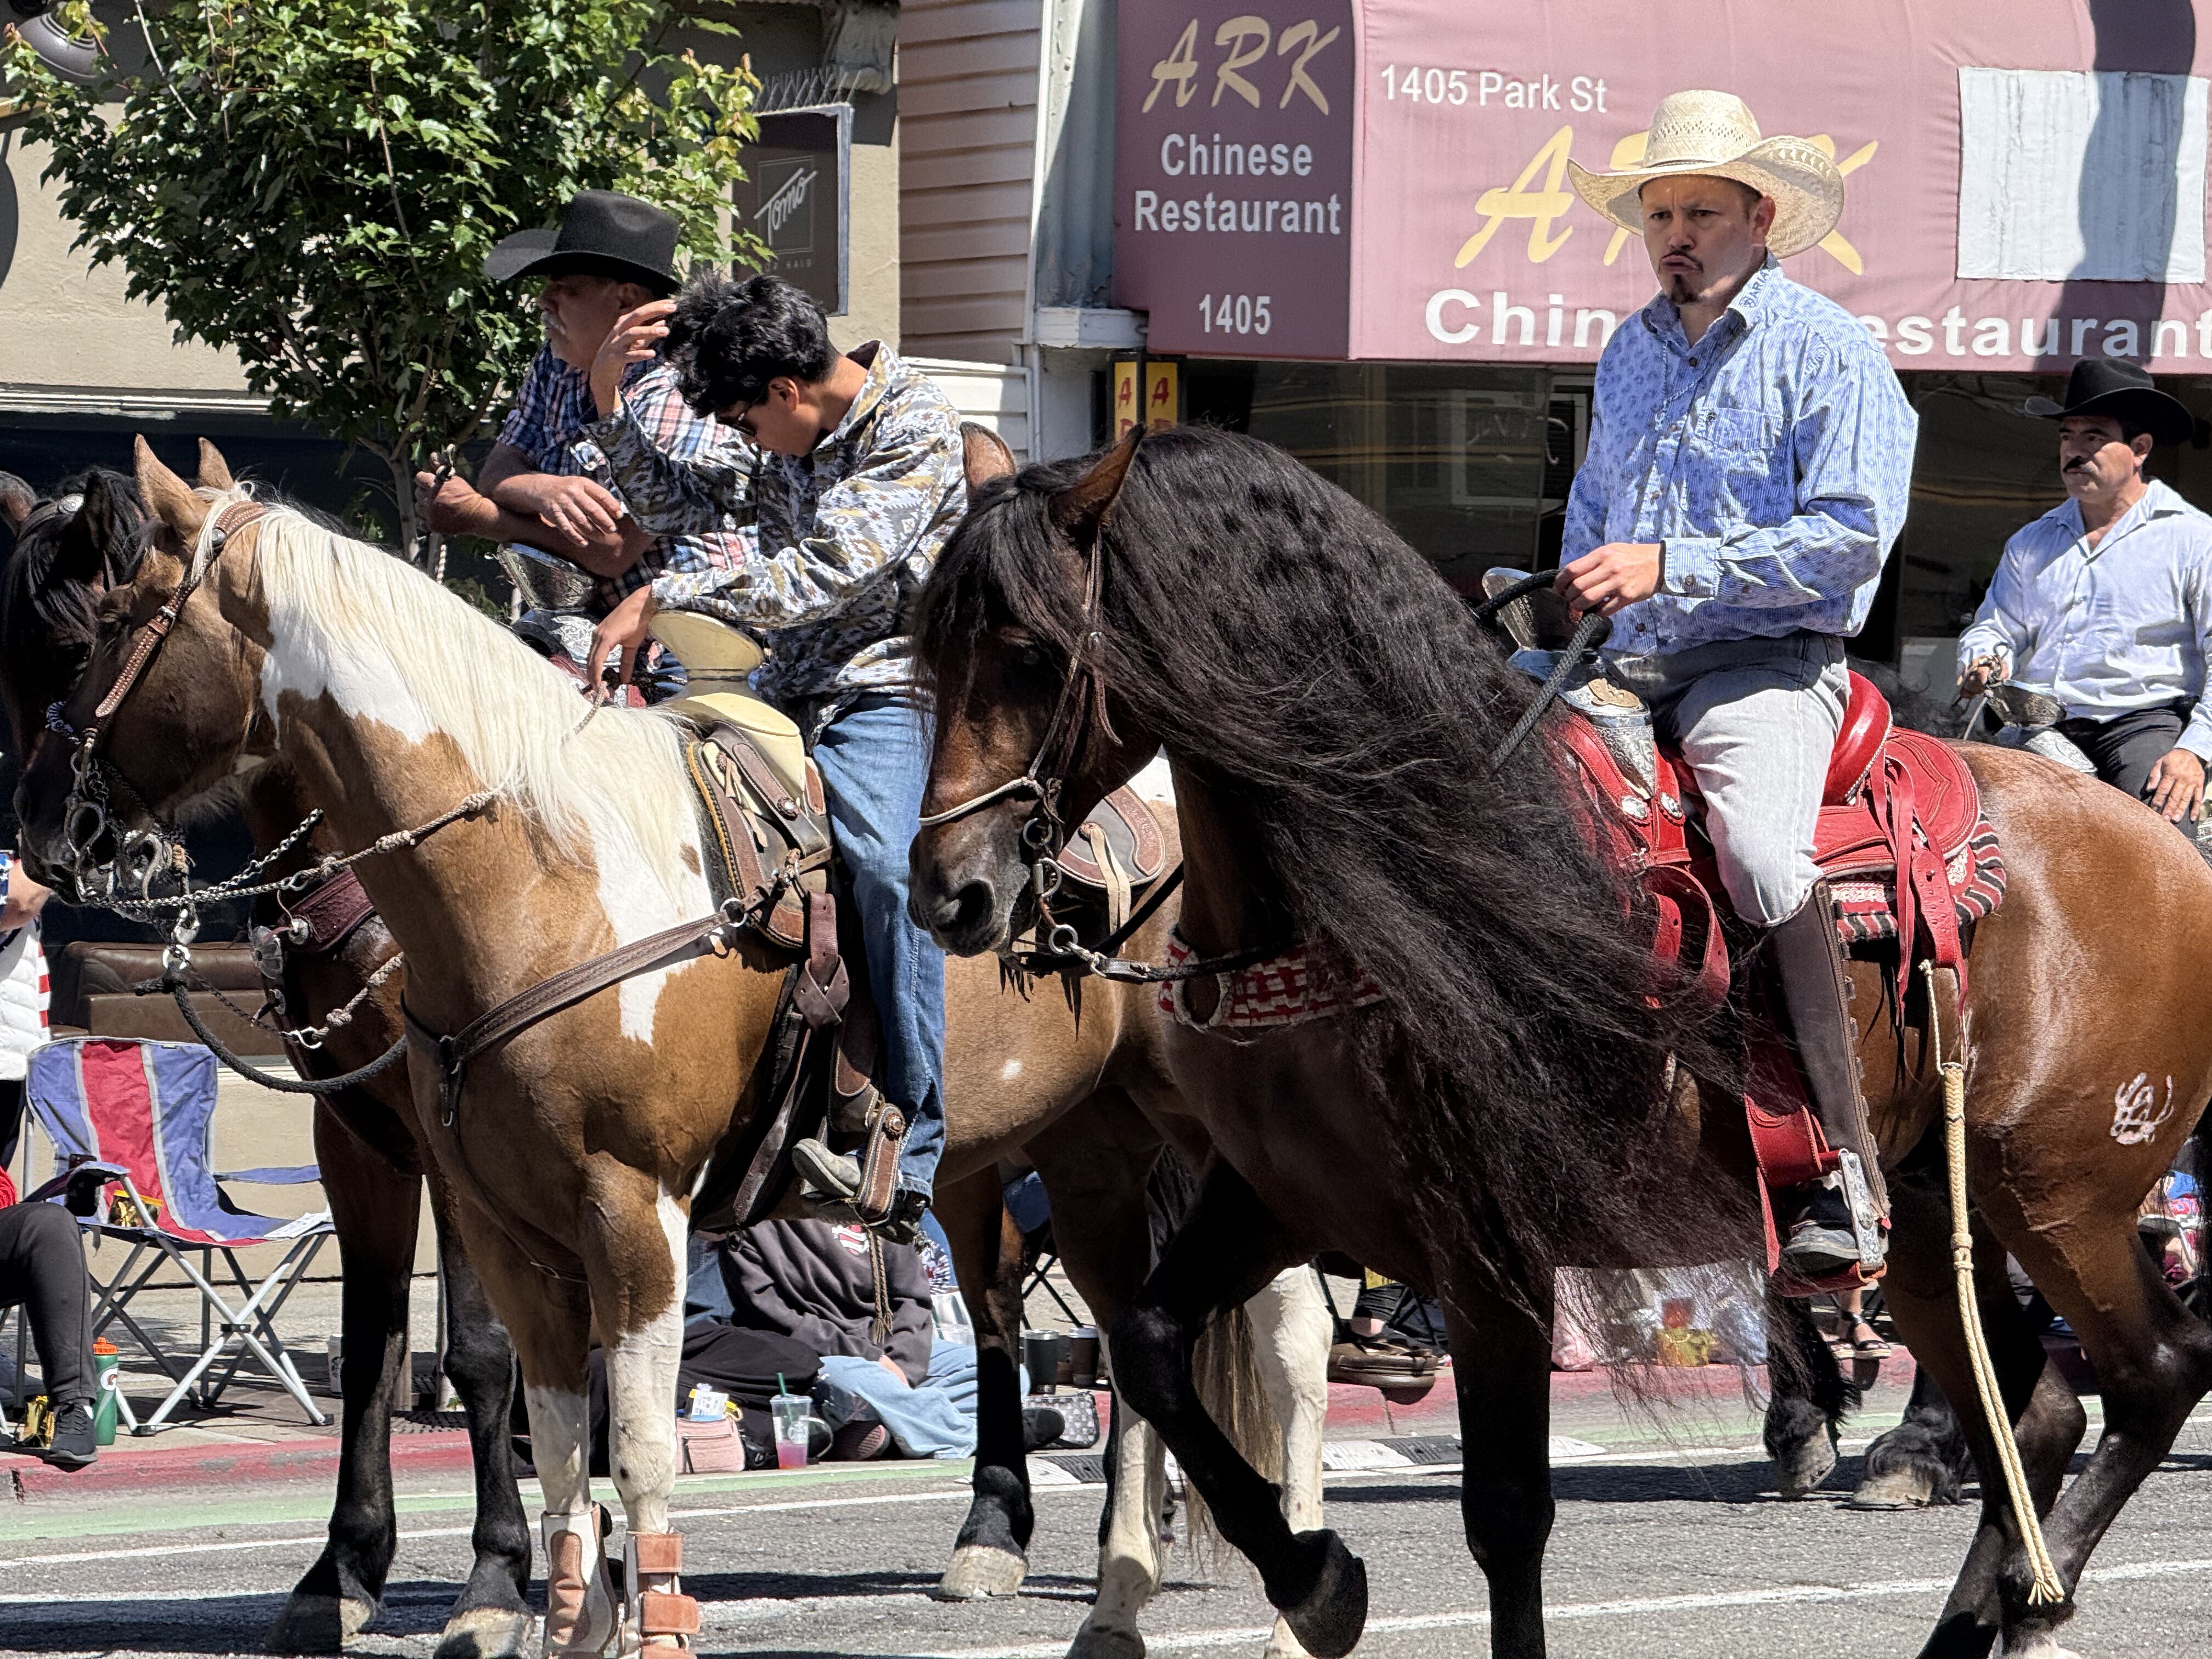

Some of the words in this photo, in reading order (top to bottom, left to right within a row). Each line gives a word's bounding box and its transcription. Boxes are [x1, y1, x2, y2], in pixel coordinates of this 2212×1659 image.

[1142, 15, 1340, 115] ARK
[1381, 65, 1468, 105] 1405
[1479, 72, 1561, 111] Park
[1570, 76, 1608, 112] St
[1161, 134, 1312, 176] Chinese
[753, 167, 817, 246] Tomo
[1135, 190, 1341, 235] Restaurant
[1199, 294, 1271, 335] 1405
[1426, 289, 1616, 348] Chin
[1857, 305, 2212, 358] estaurant
